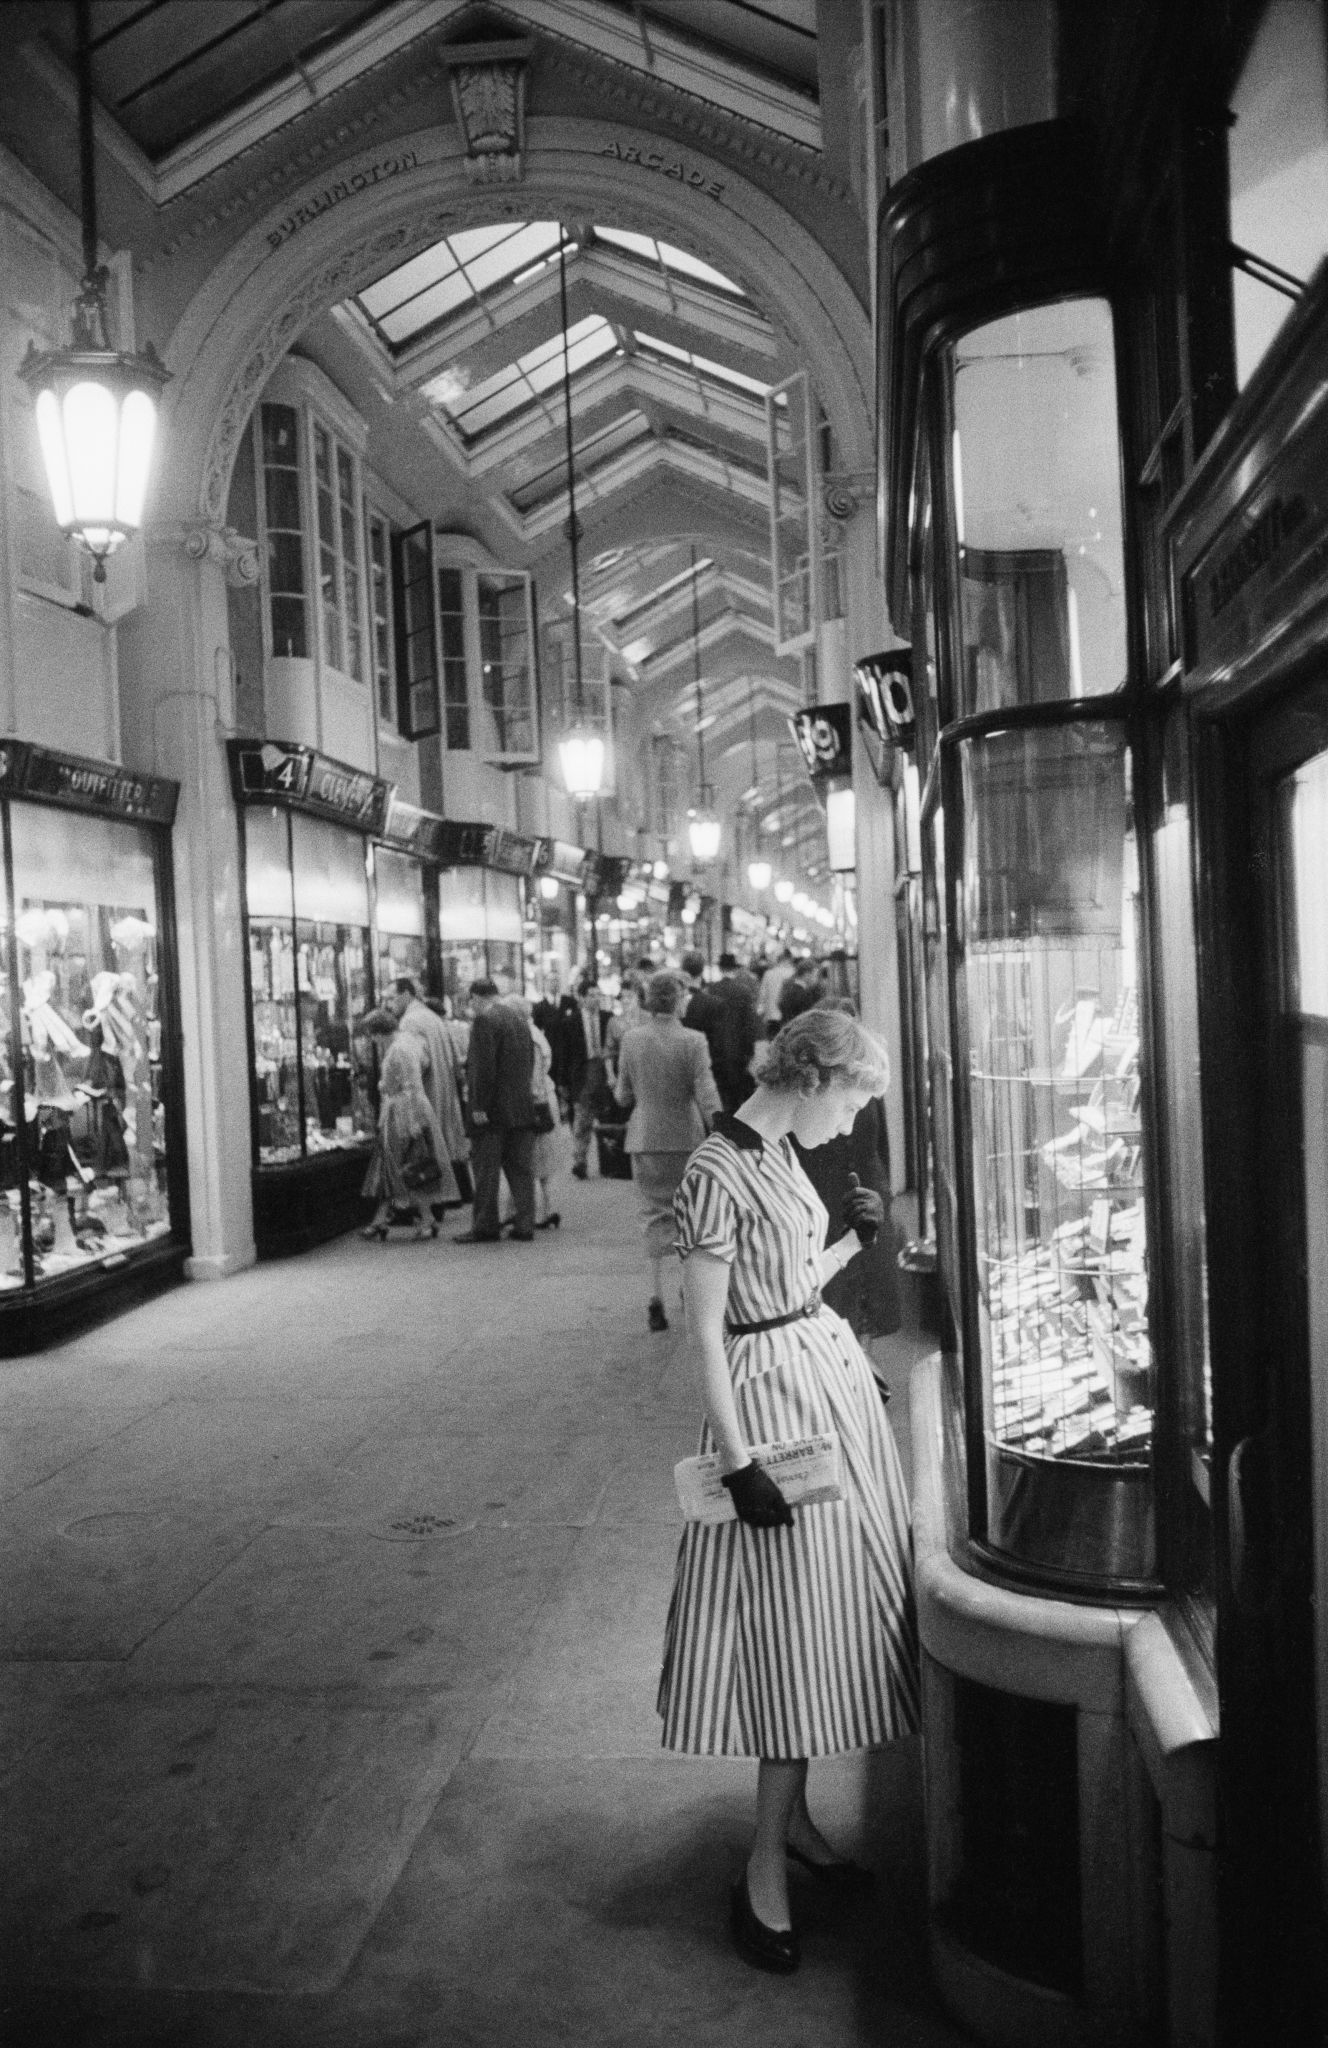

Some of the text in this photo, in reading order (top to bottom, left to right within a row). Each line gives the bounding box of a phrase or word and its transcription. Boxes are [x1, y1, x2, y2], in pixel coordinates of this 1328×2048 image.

[266, 142, 725, 249] BURLINGTON ARCADE
[277, 760, 294, 789] 4
[766, 1445, 814, 1465] BARRETT
